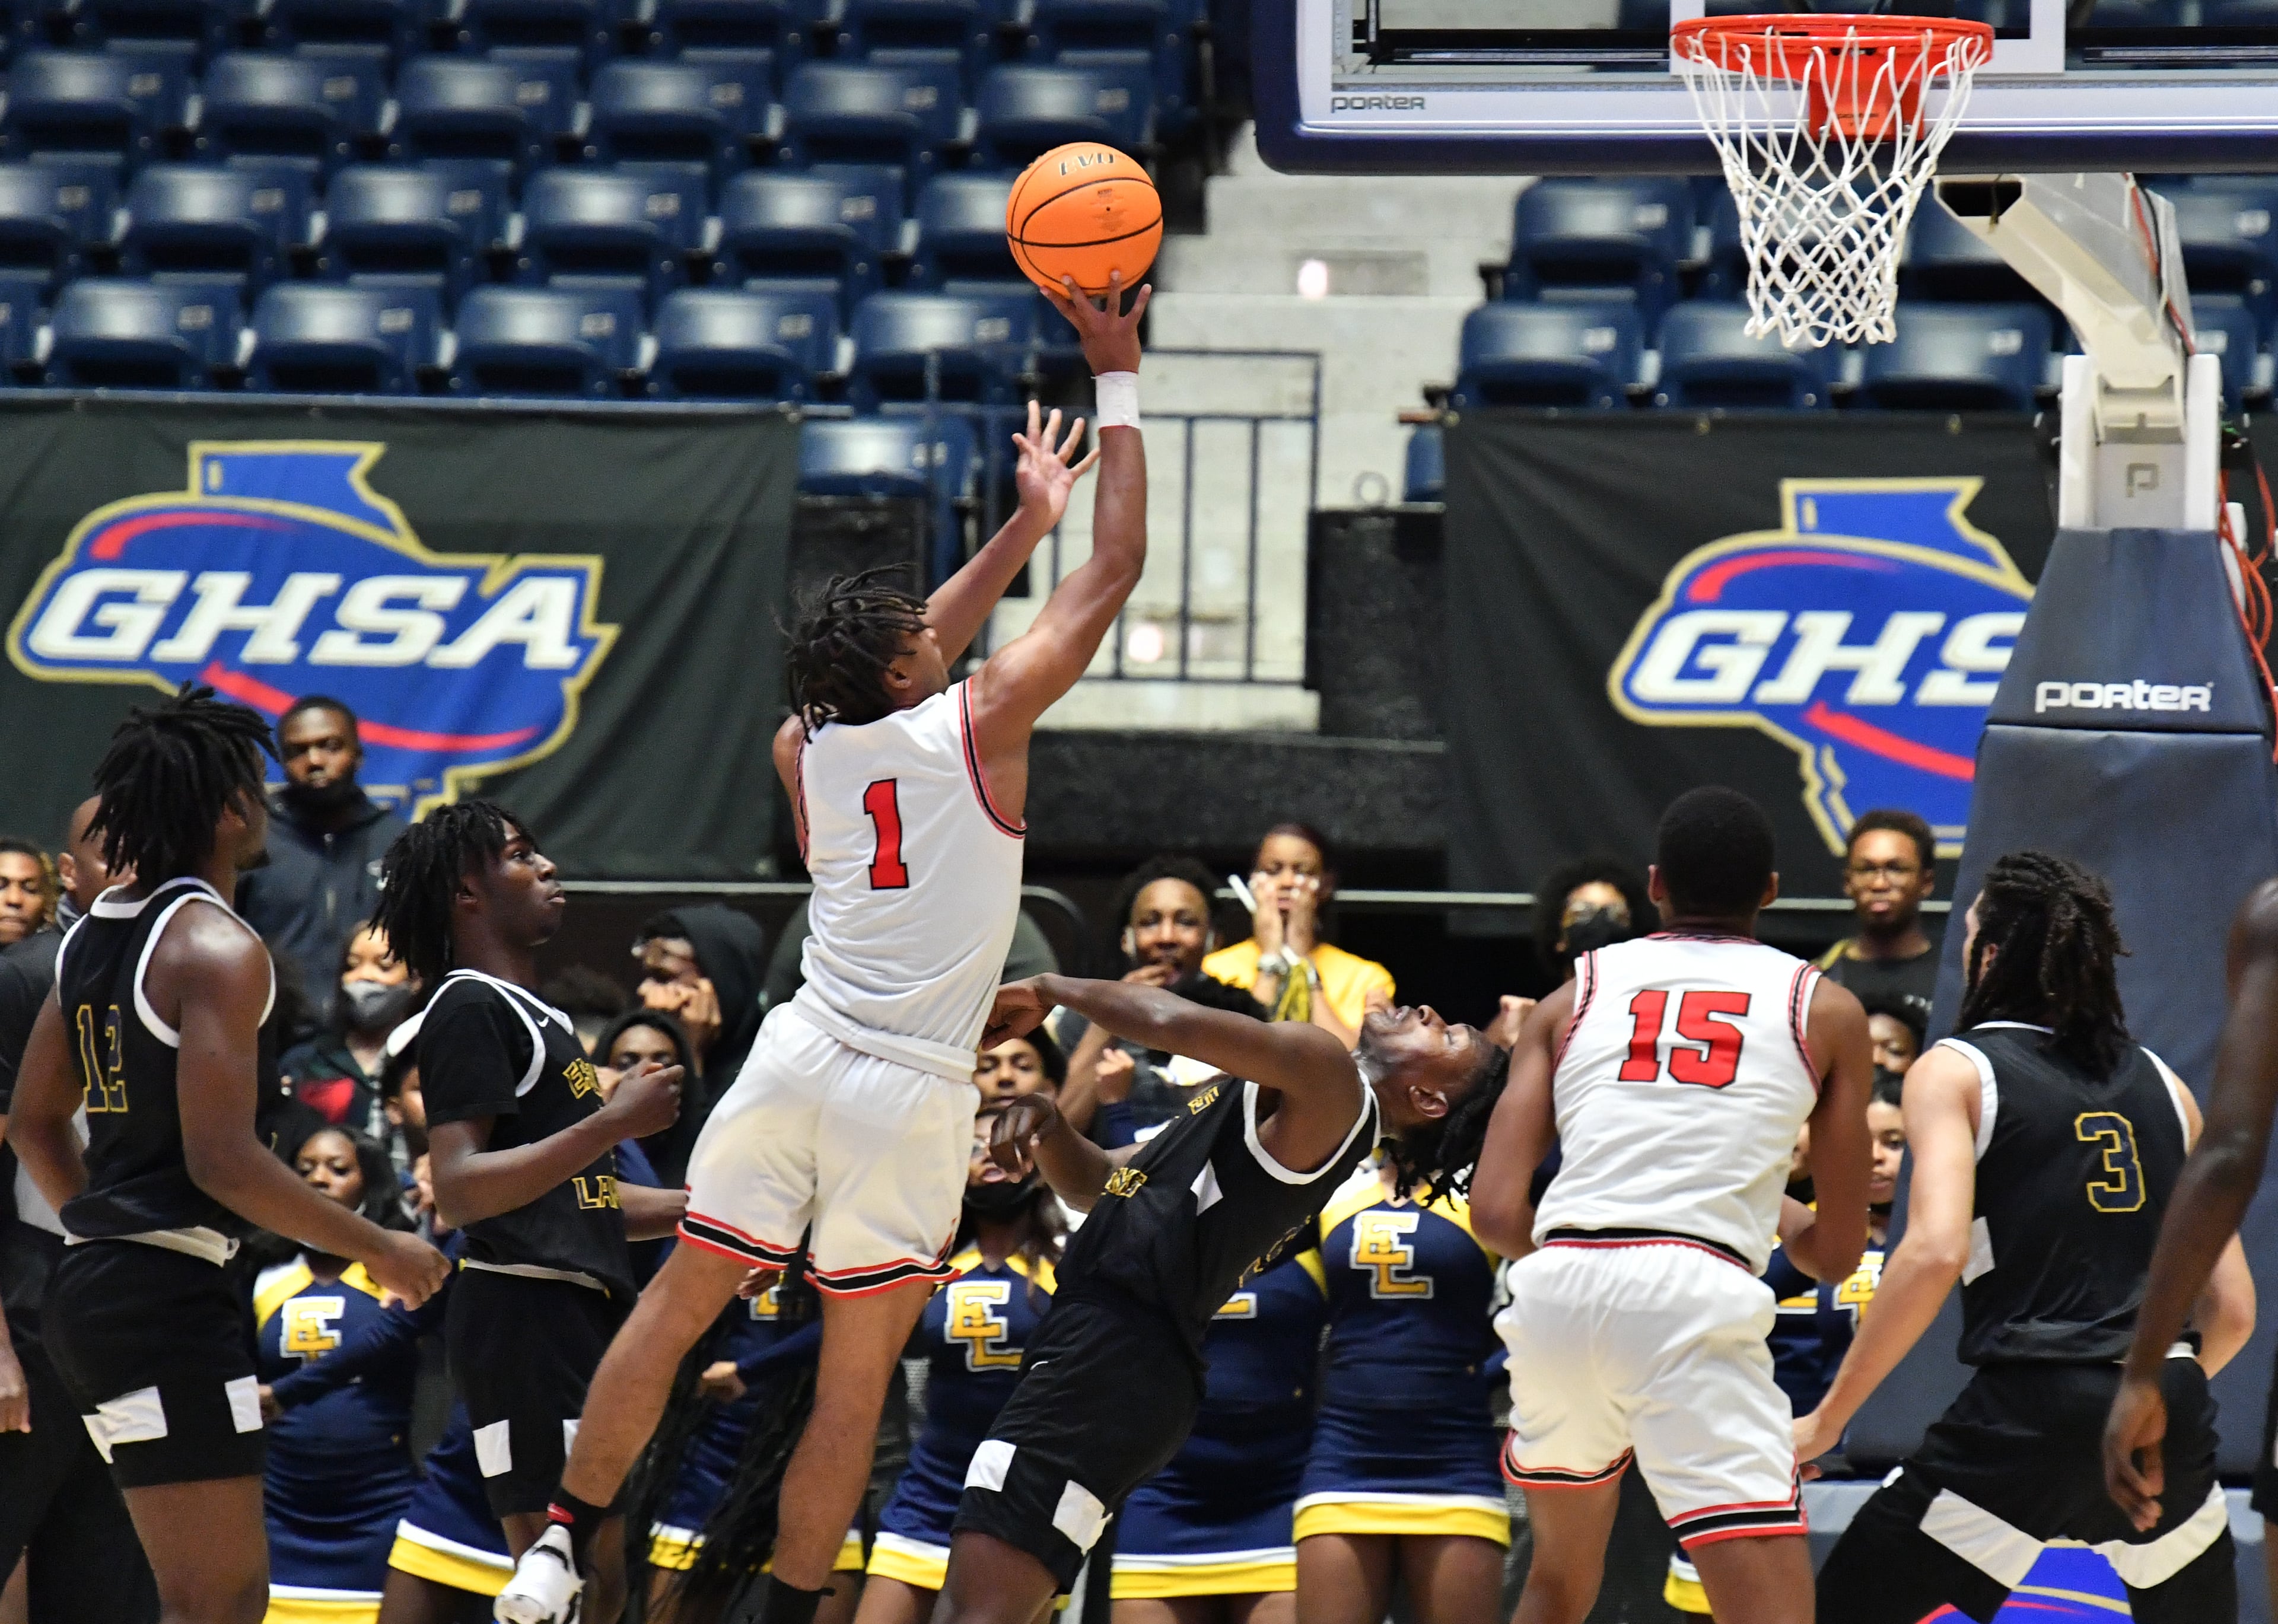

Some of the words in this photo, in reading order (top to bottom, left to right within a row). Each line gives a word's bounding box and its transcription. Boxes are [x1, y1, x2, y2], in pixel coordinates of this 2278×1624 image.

[27, 568, 581, 670] GHSA
[1630, 609, 2027, 707] GHS
[863, 778, 909, 890] 1
[77, 1004, 128, 1113] 12
[1618, 989, 1752, 1089] 15
[2074, 1112, 2146, 1212] 3
